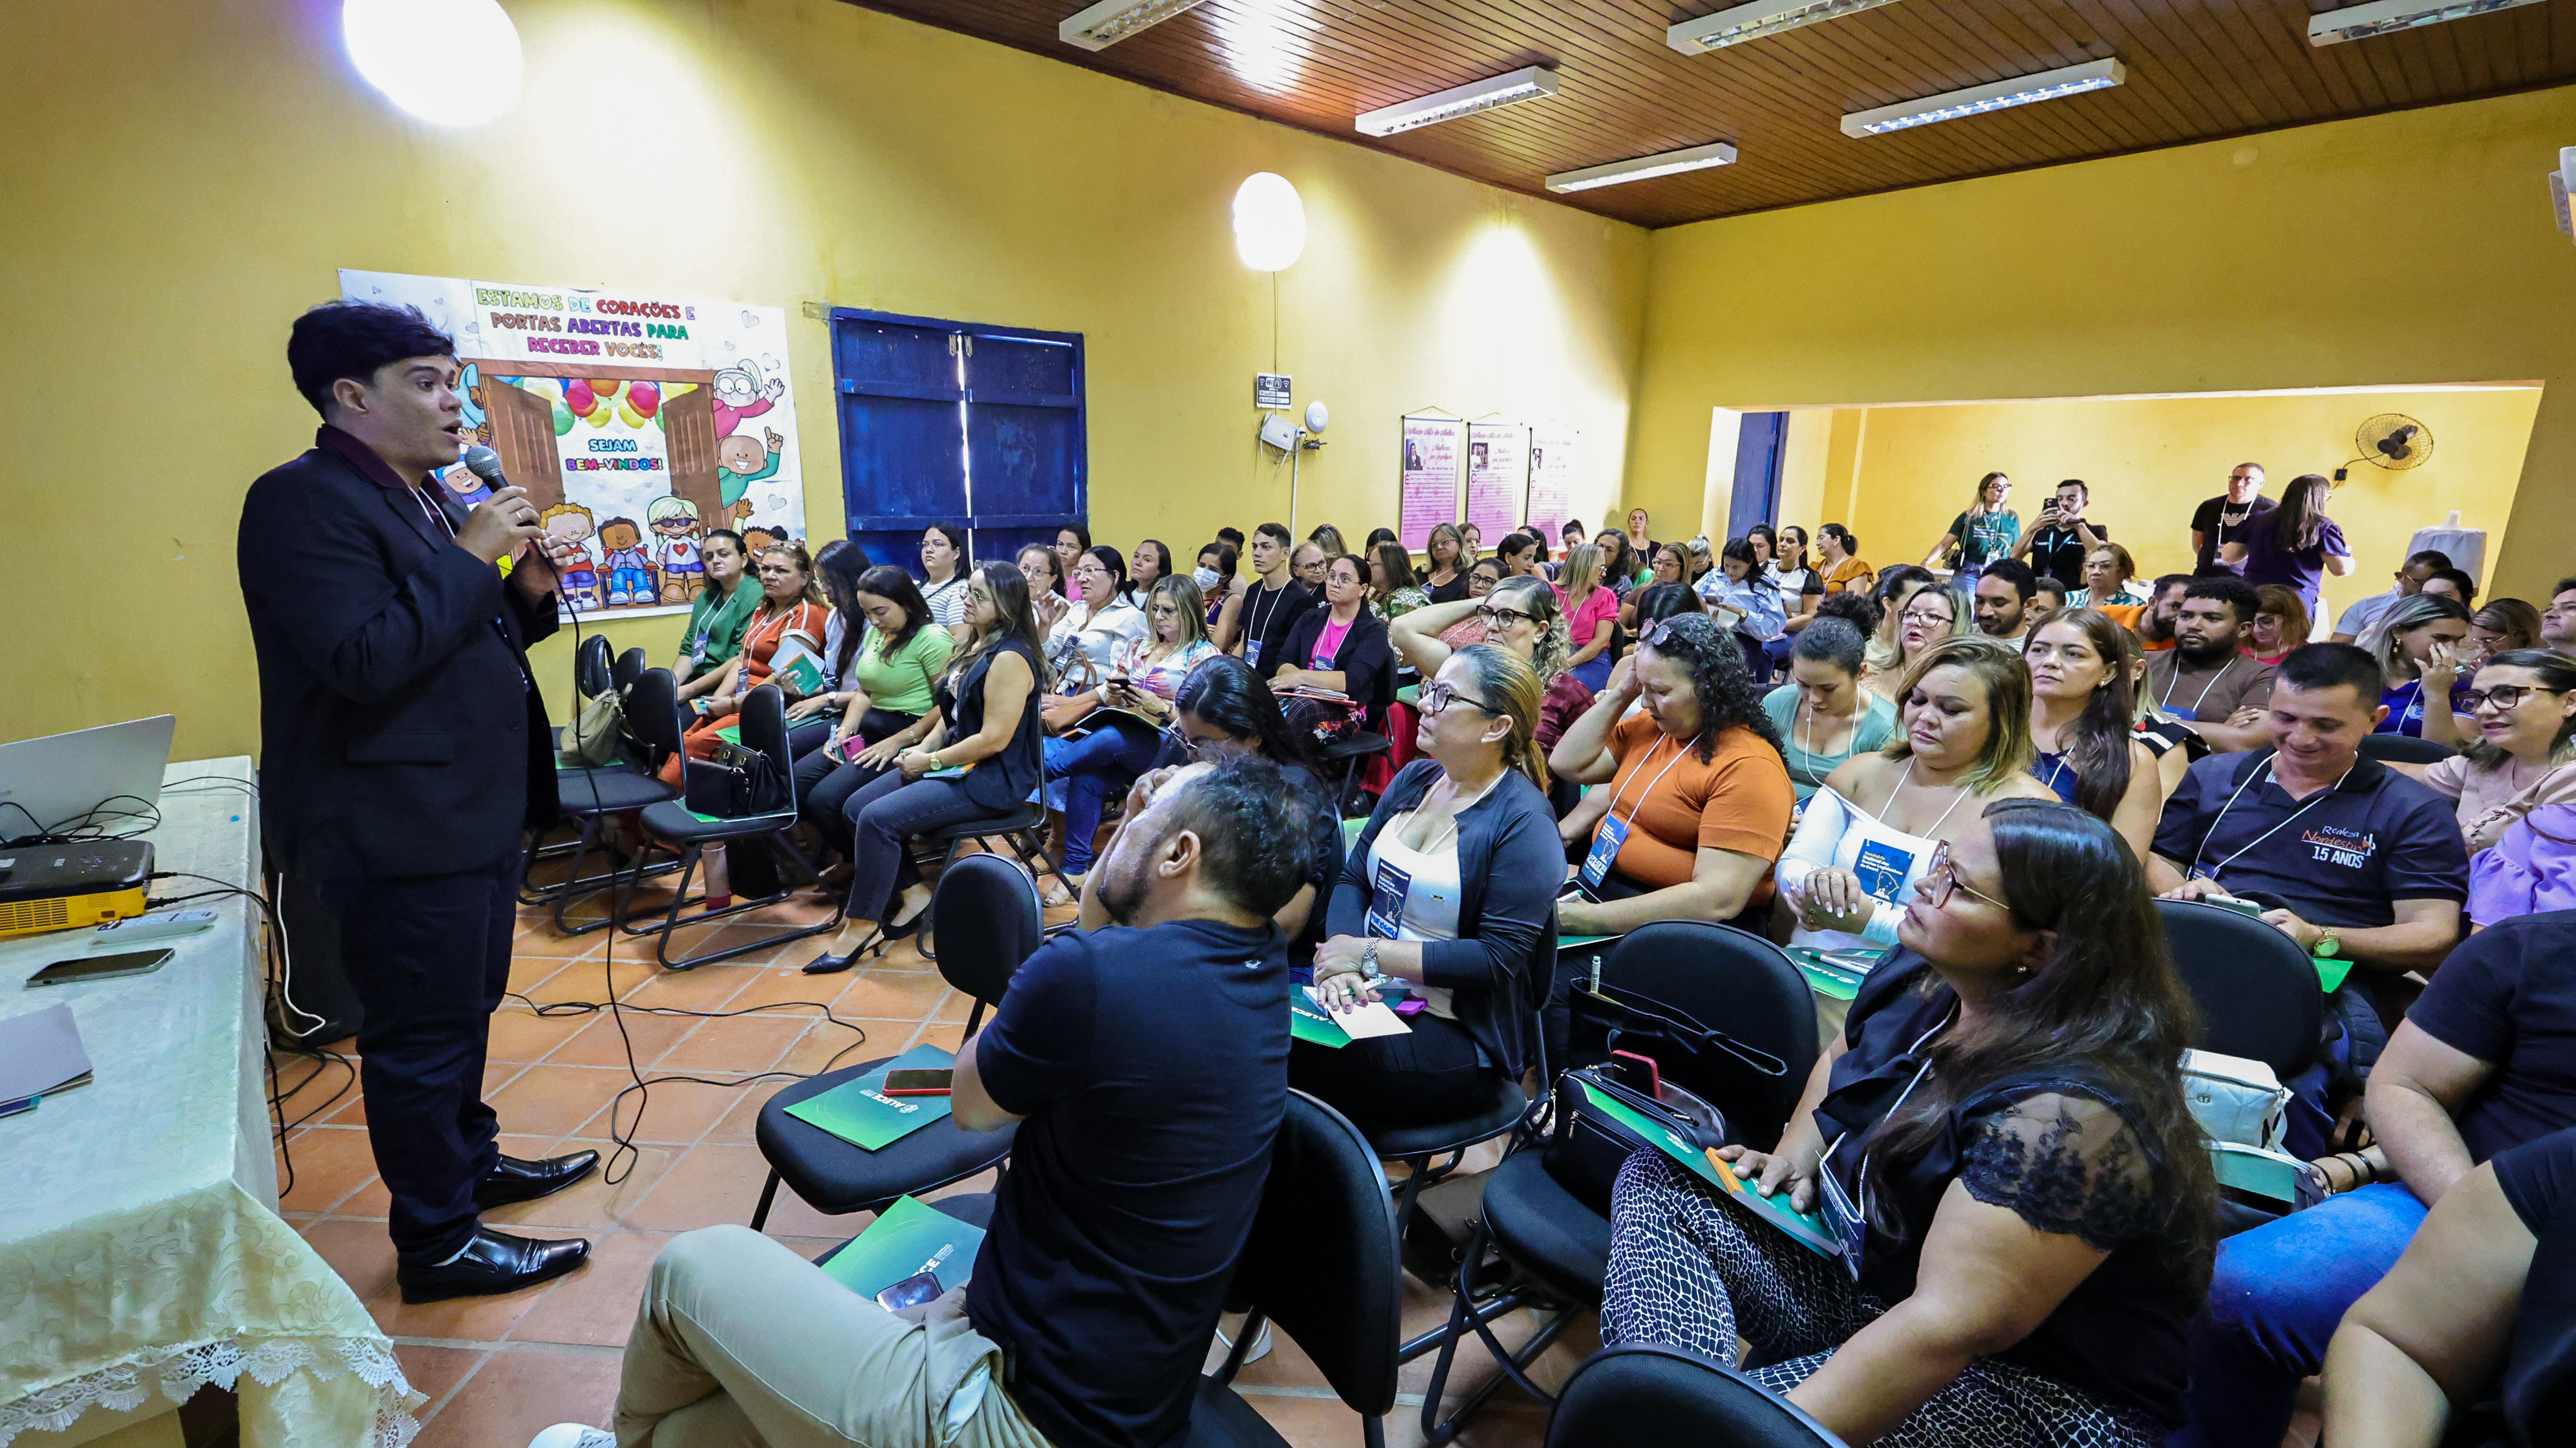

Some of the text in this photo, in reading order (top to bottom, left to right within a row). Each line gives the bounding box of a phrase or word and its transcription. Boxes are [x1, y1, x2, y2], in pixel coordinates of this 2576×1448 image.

[477, 288, 695, 320] ESTAMOS DE CORAÇÕES E
[491, 312, 689, 340] PORTAS ABERTAS PARA
[527, 337, 663, 361] RECEBER VOCÊS!
[588, 439, 638, 452] SEJAM
[565, 458, 663, 471] BEM-VINDOS!
[2302, 829, 2365, 852] Nordestin
[2322, 825, 2359, 838] Realeza
[2312, 846, 2364, 868] 15 ANOS
[871, 1093, 906, 1108] ALECE
